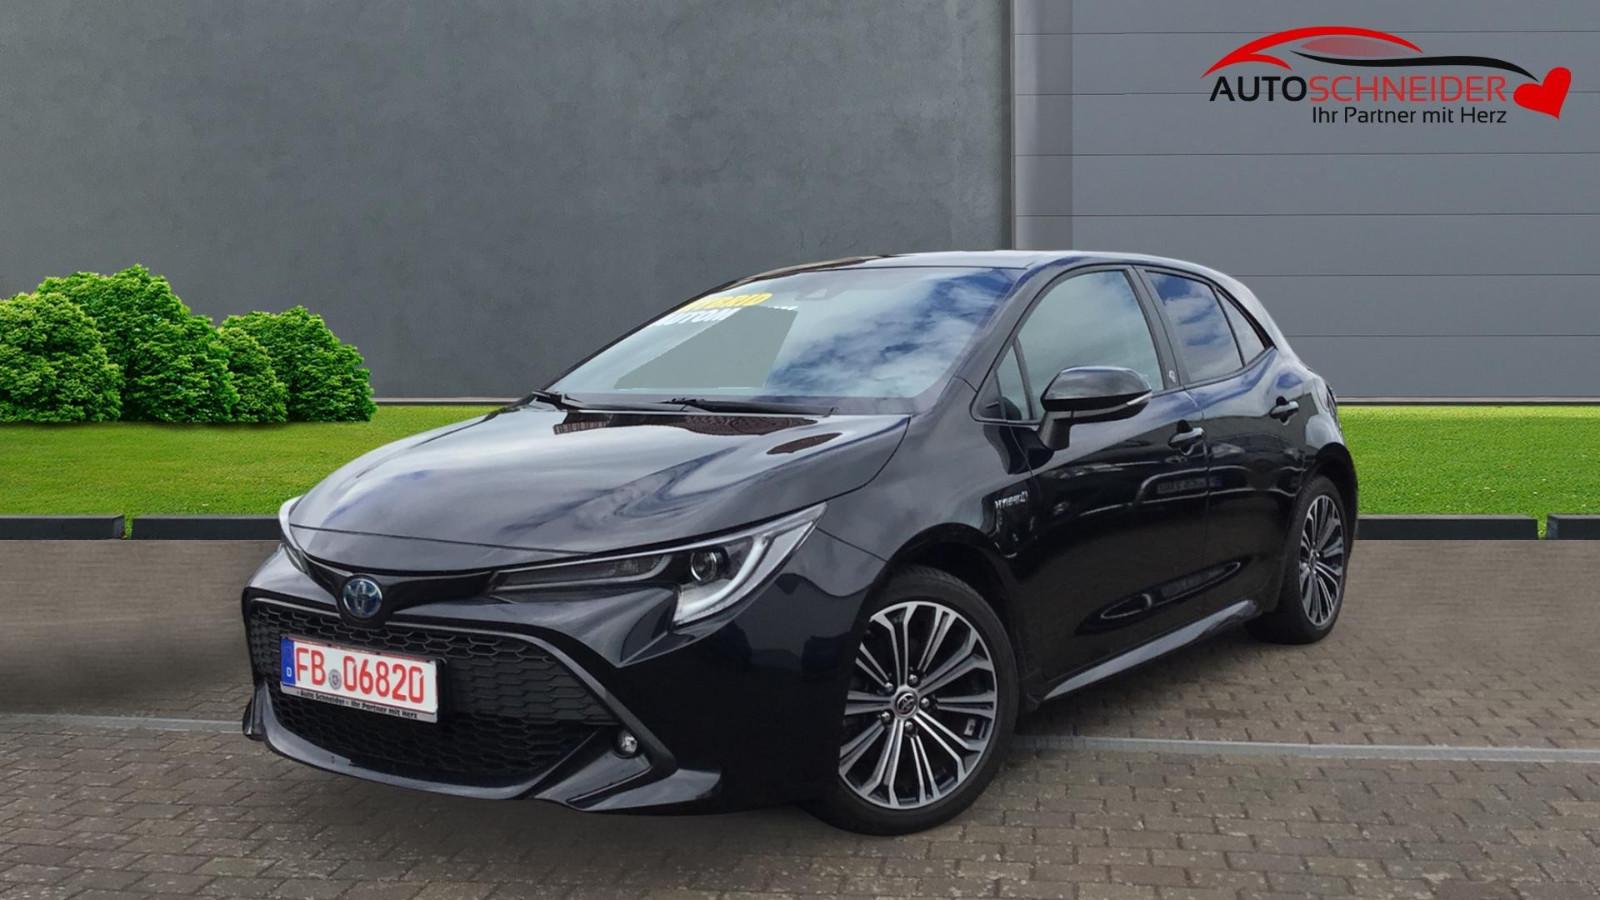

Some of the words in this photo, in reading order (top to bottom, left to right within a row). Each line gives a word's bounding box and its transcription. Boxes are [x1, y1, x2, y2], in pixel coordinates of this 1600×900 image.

[286, 667, 292, 677] D
[295, 647, 326, 686] FB
[342, 655, 424, 704] 06820
